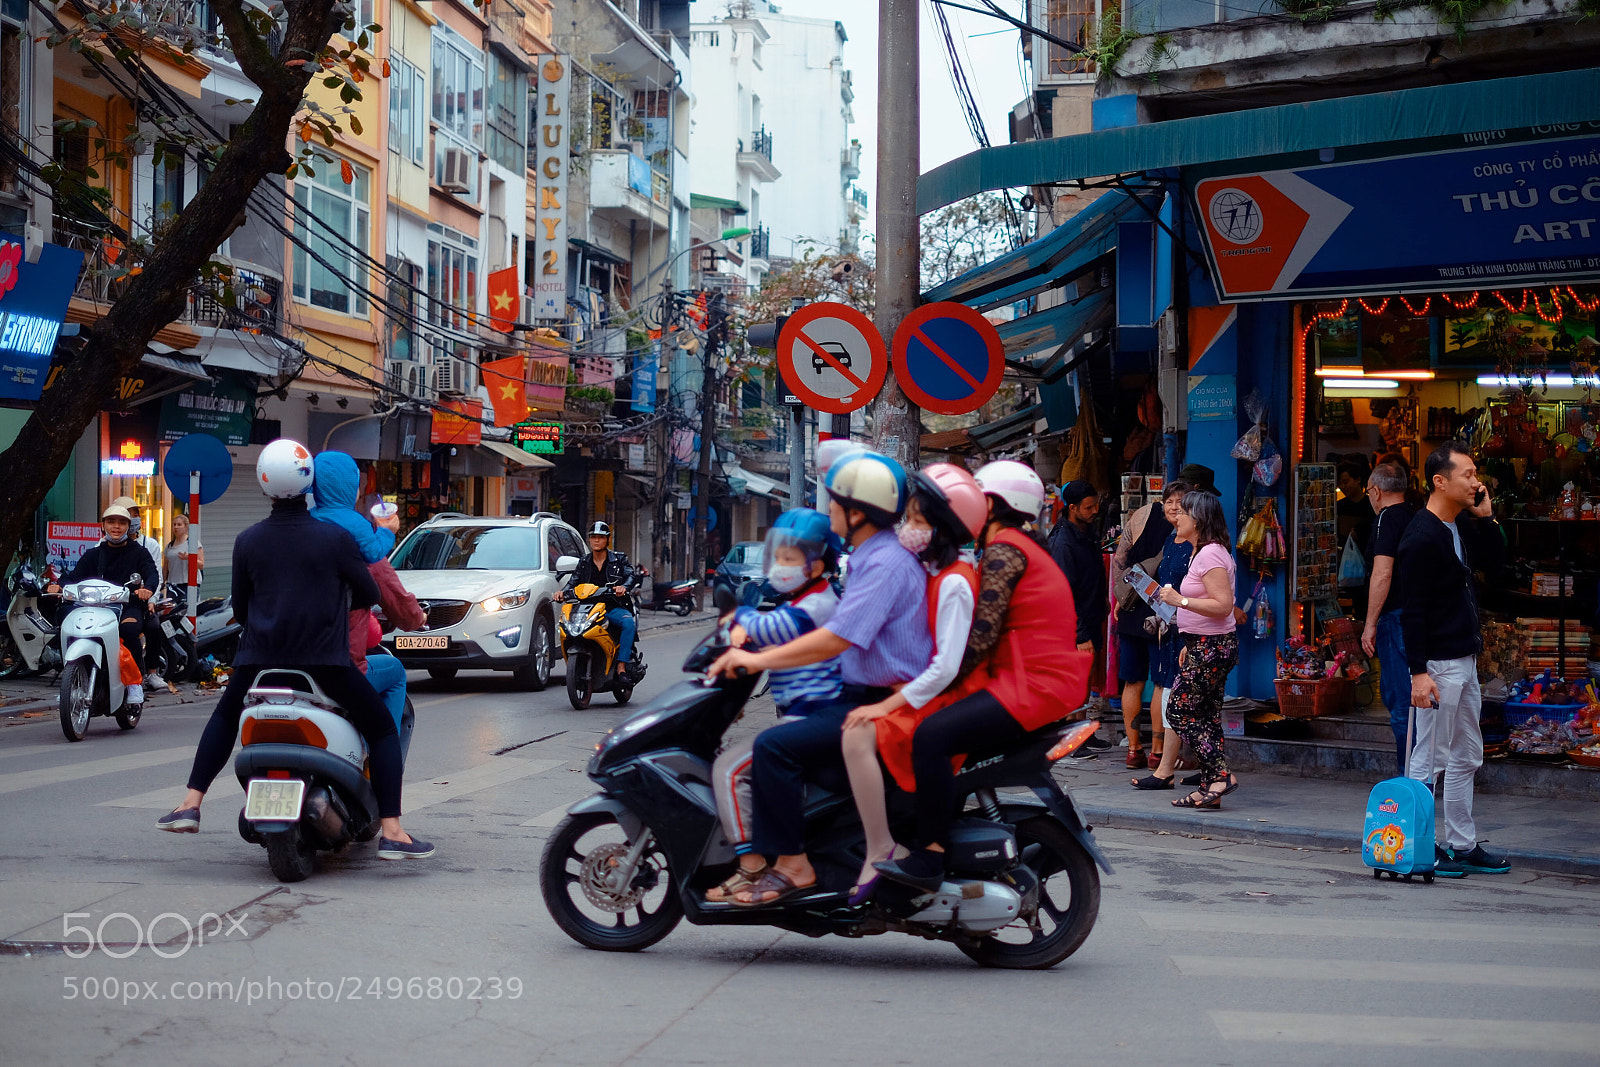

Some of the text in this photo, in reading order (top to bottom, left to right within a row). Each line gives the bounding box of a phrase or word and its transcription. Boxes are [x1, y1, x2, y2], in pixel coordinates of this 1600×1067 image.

[1473, 149, 1600, 178] CÔNG TY CỔ PHẦ
[541, 93, 562, 275] LUCKY 2
[1453, 179, 1539, 213] THỦ
[1513, 218, 1597, 244] ART
[1438, 267, 1464, 277] TRUNG
[1465, 264, 1484, 276] TÂM
[1485, 264, 1505, 274] KINH
[1506, 262, 1536, 273] DOANH
[1567, 259, 1582, 268] THI
[535, 282, 566, 292] HOTEL
[52, 525, 82, 538] EXCHANGE
[397, 637, 446, 648] 30A-270.46
[253, 800, 293, 817] 5805
